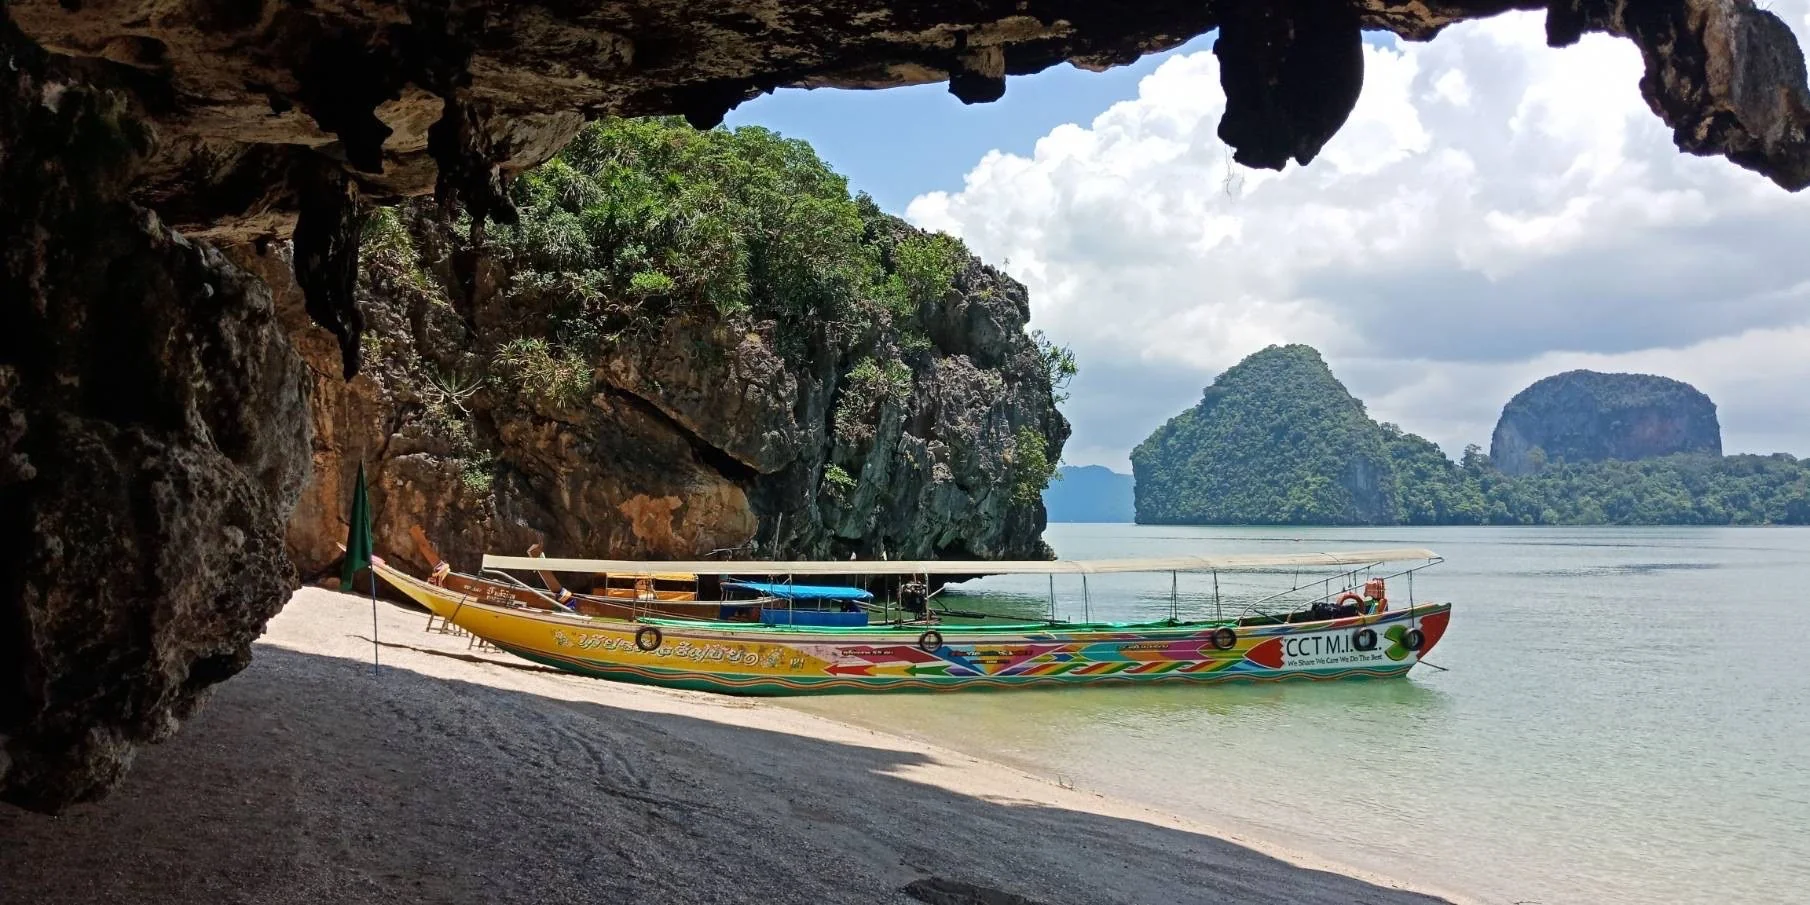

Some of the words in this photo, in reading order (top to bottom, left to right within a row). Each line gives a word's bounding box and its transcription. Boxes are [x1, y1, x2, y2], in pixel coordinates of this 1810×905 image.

[1287, 659, 1298, 667] We
[1299, 658, 1315, 666] Share
[1326, 656, 1339, 664] Care
[1340, 655, 1350, 663] We
[1350, 654, 1359, 662] Do
[1359, 653, 1370, 661] The
[1371, 652, 1383, 661] Best
